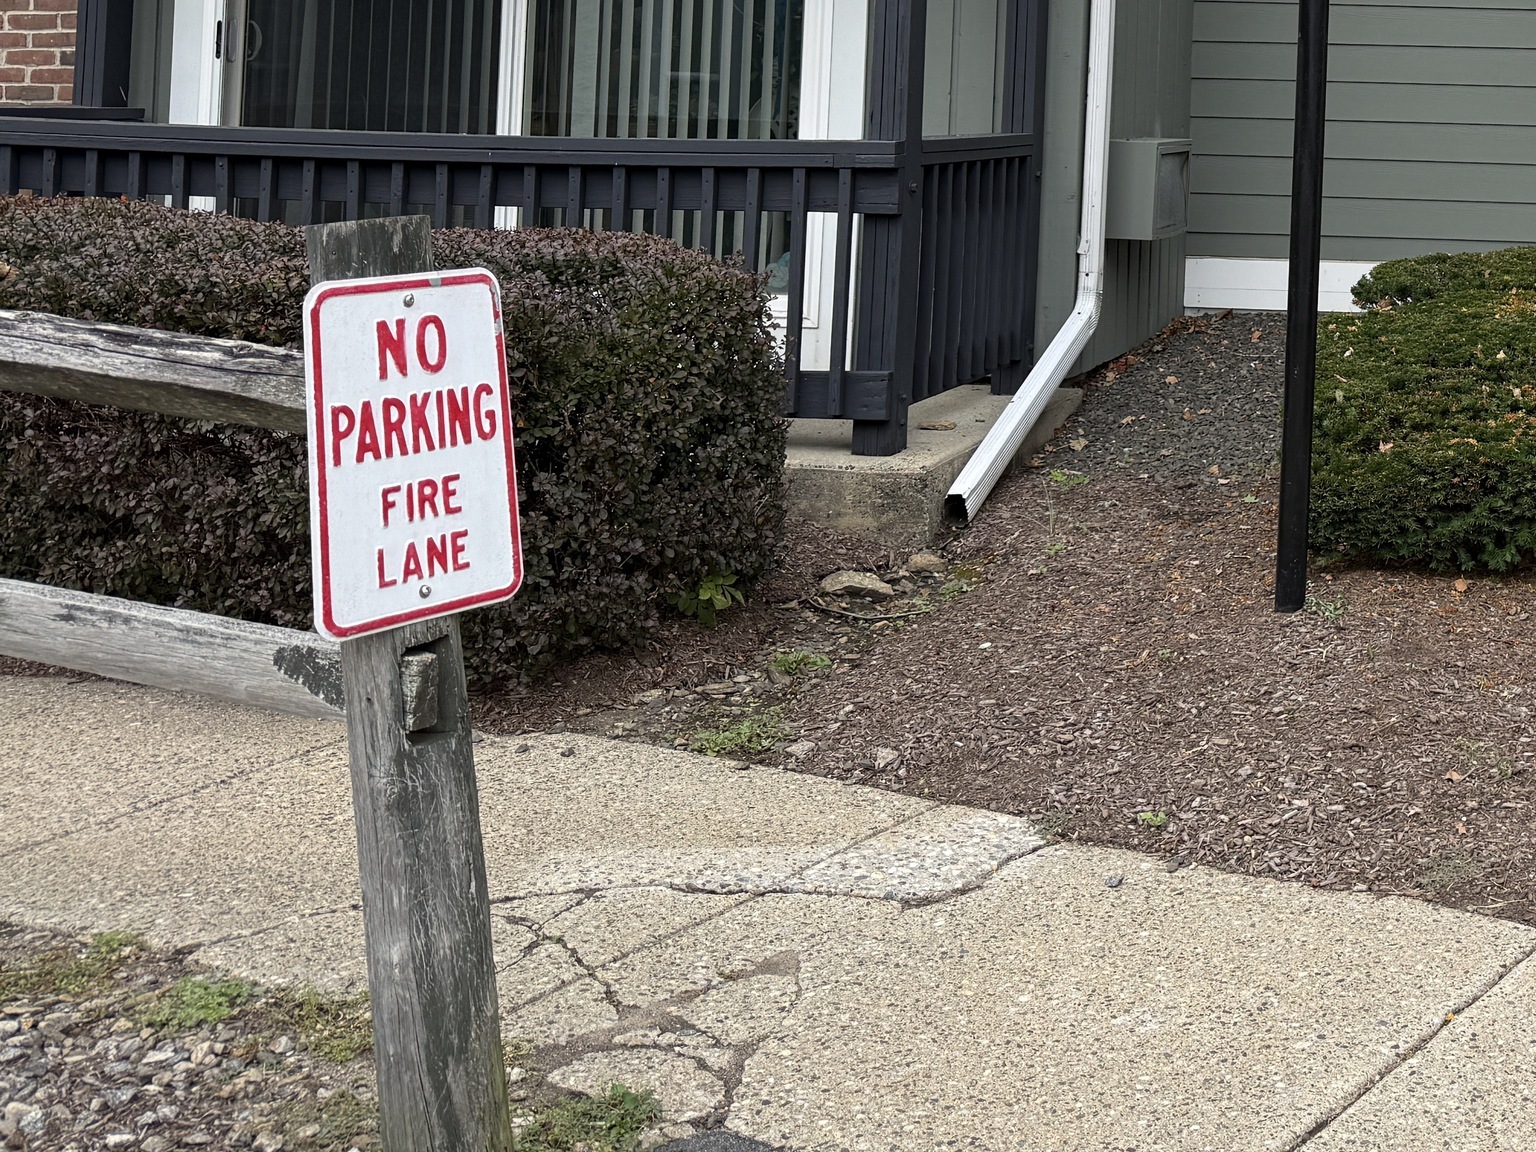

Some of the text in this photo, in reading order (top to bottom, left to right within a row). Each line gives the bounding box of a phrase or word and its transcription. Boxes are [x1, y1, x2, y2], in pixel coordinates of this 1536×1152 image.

[375, 314, 448, 381] NO
[331, 382, 498, 468] PARKING
[381, 473, 463, 527] FIRE
[377, 529, 470, 589] LANE
